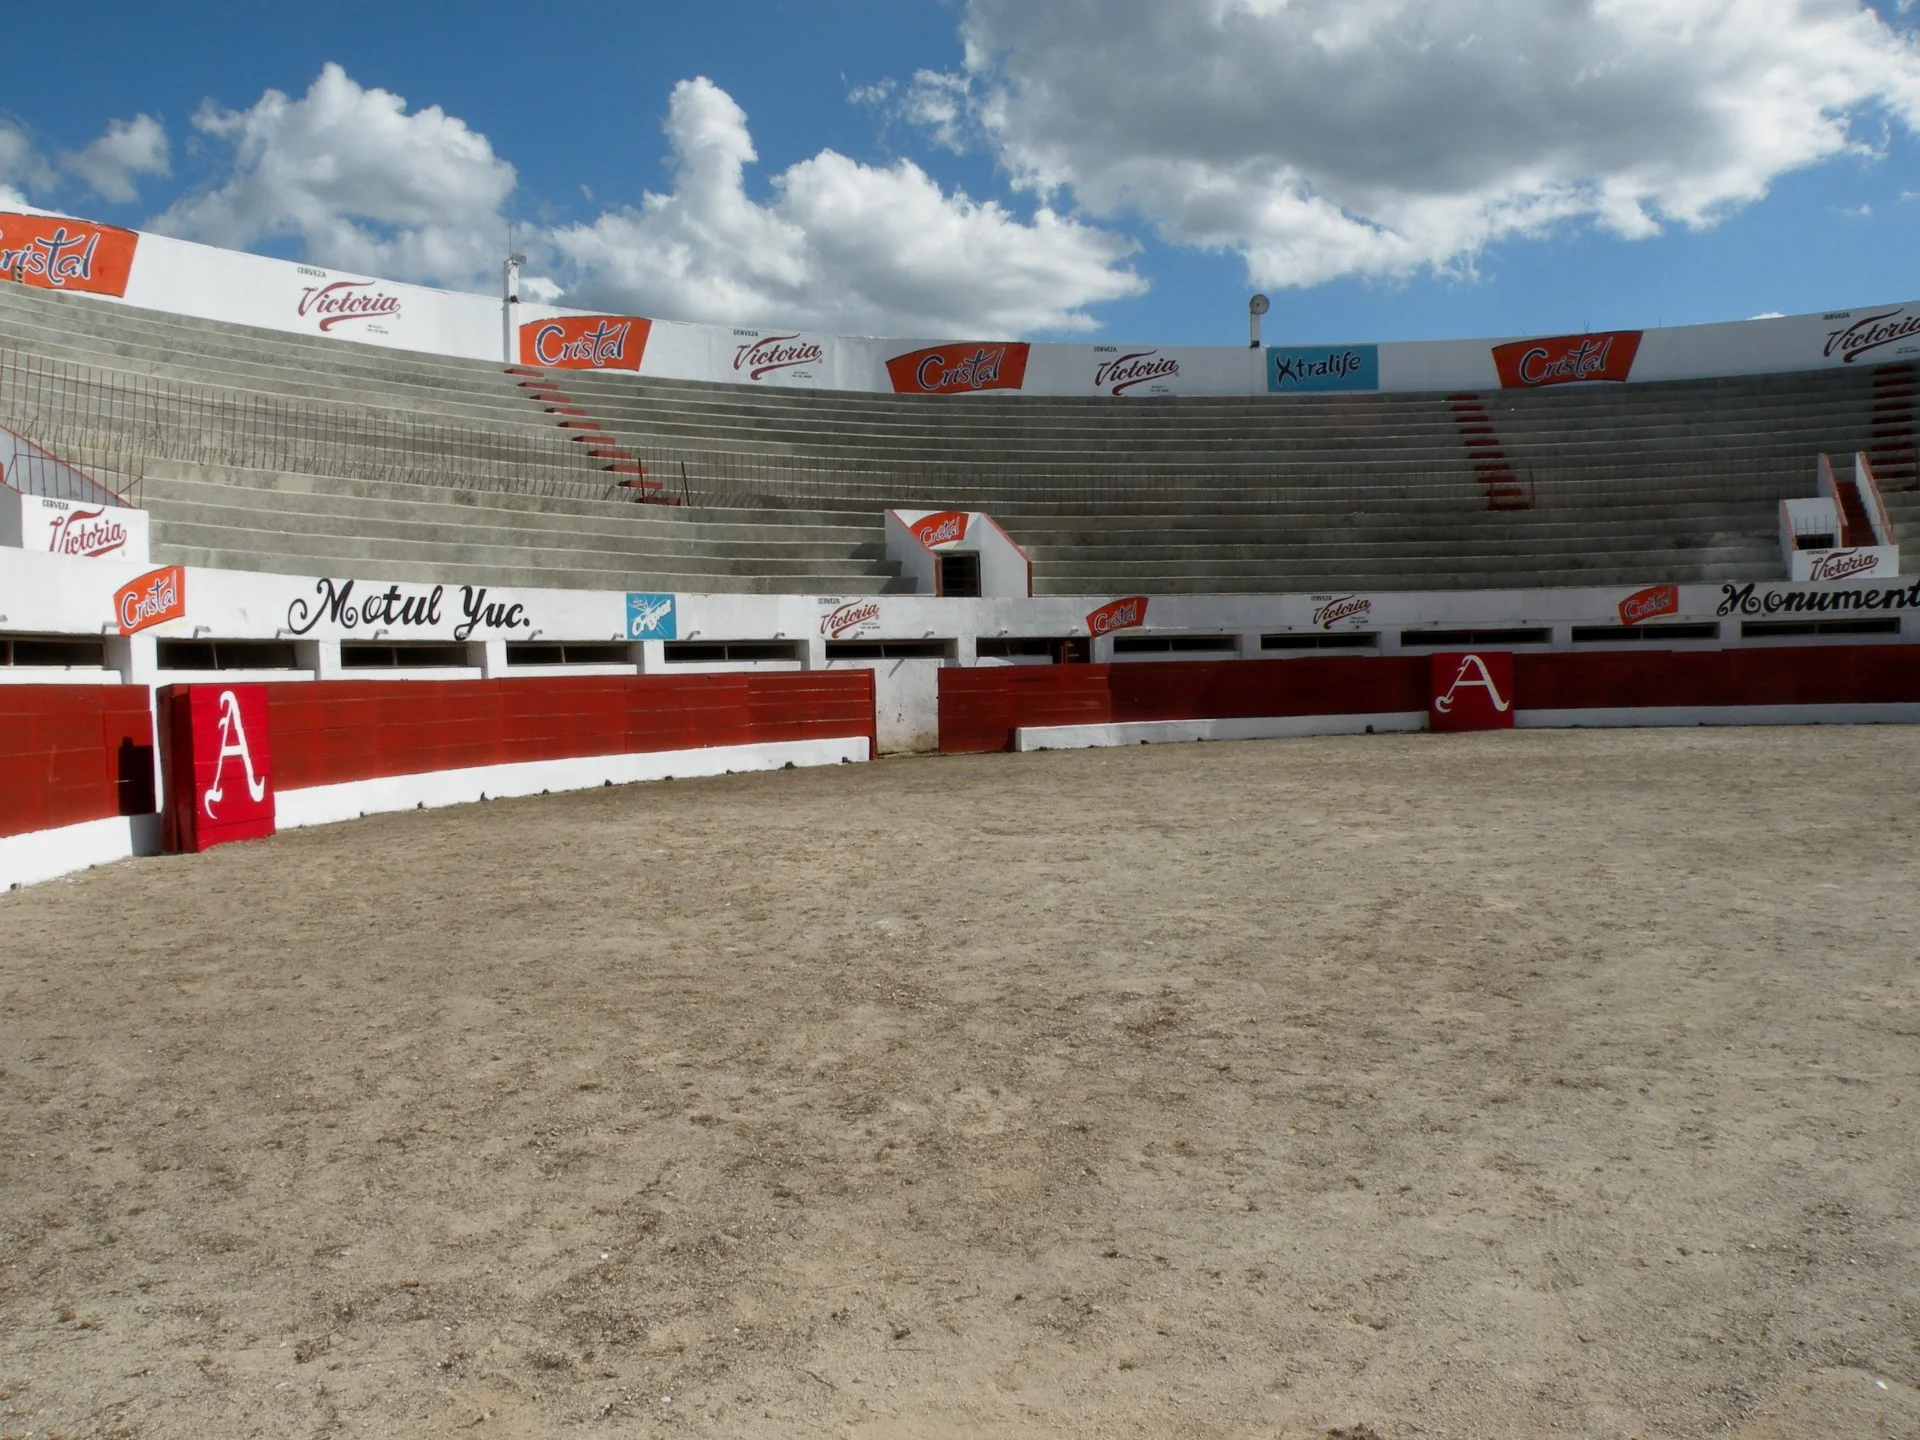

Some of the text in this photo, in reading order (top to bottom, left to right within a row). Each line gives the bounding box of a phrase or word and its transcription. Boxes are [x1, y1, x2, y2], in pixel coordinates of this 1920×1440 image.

[0, 227, 100, 285] ristal
[297, 266, 326, 278] CERVEZA
[298, 280, 401, 332] Victoria
[1822, 312, 1850, 321] CERVEZA
[534, 320, 632, 367] Cristal
[733, 329, 759, 337] CERVEZA
[733, 332, 823, 380] Victoria
[916, 346, 1006, 390] Cristal
[1094, 348, 1180, 396] Victoria
[1275, 349, 1362, 388] Xtralife
[1518, 336, 1613, 384] Cristal
[42, 499, 69, 510] CERVEZA
[49, 506, 127, 558] Victoria
[919, 515, 961, 545] Cristal
[1810, 548, 1879, 581] Victoria
[120, 570, 178, 629] Cristal
[287, 577, 531, 641] Motul Yuc.
[817, 597, 840, 605] CERVEZA
[820, 598, 880, 638] Victoria
[1093, 599, 1138, 633] Cristal
[1312, 594, 1372, 630] Victoria
[1623, 587, 1673, 620] Cristal
[1435, 654, 1510, 713] A
[204, 690, 266, 820] A
